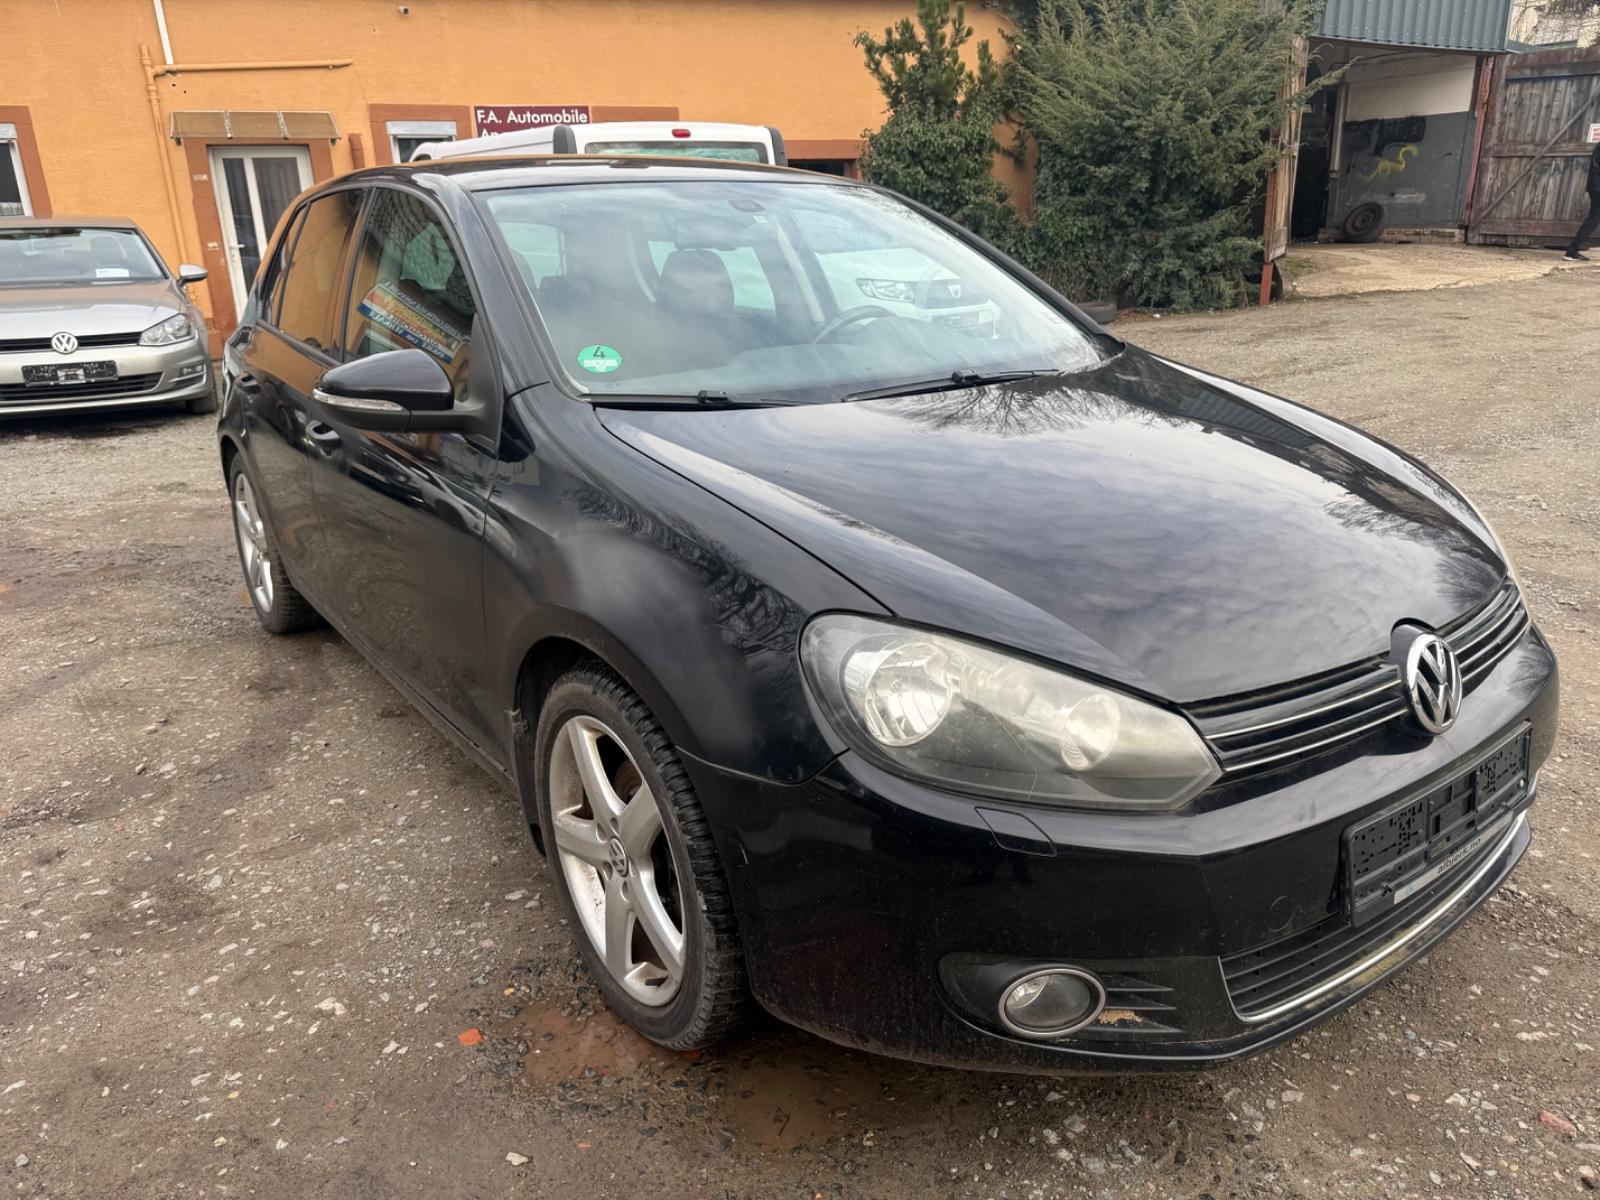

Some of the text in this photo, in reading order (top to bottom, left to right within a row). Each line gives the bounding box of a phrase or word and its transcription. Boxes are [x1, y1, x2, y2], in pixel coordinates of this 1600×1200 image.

[476, 108, 588, 124] F.A. Automobile
[592, 346, 606, 359] 4
[1409, 634, 1460, 732] VW
